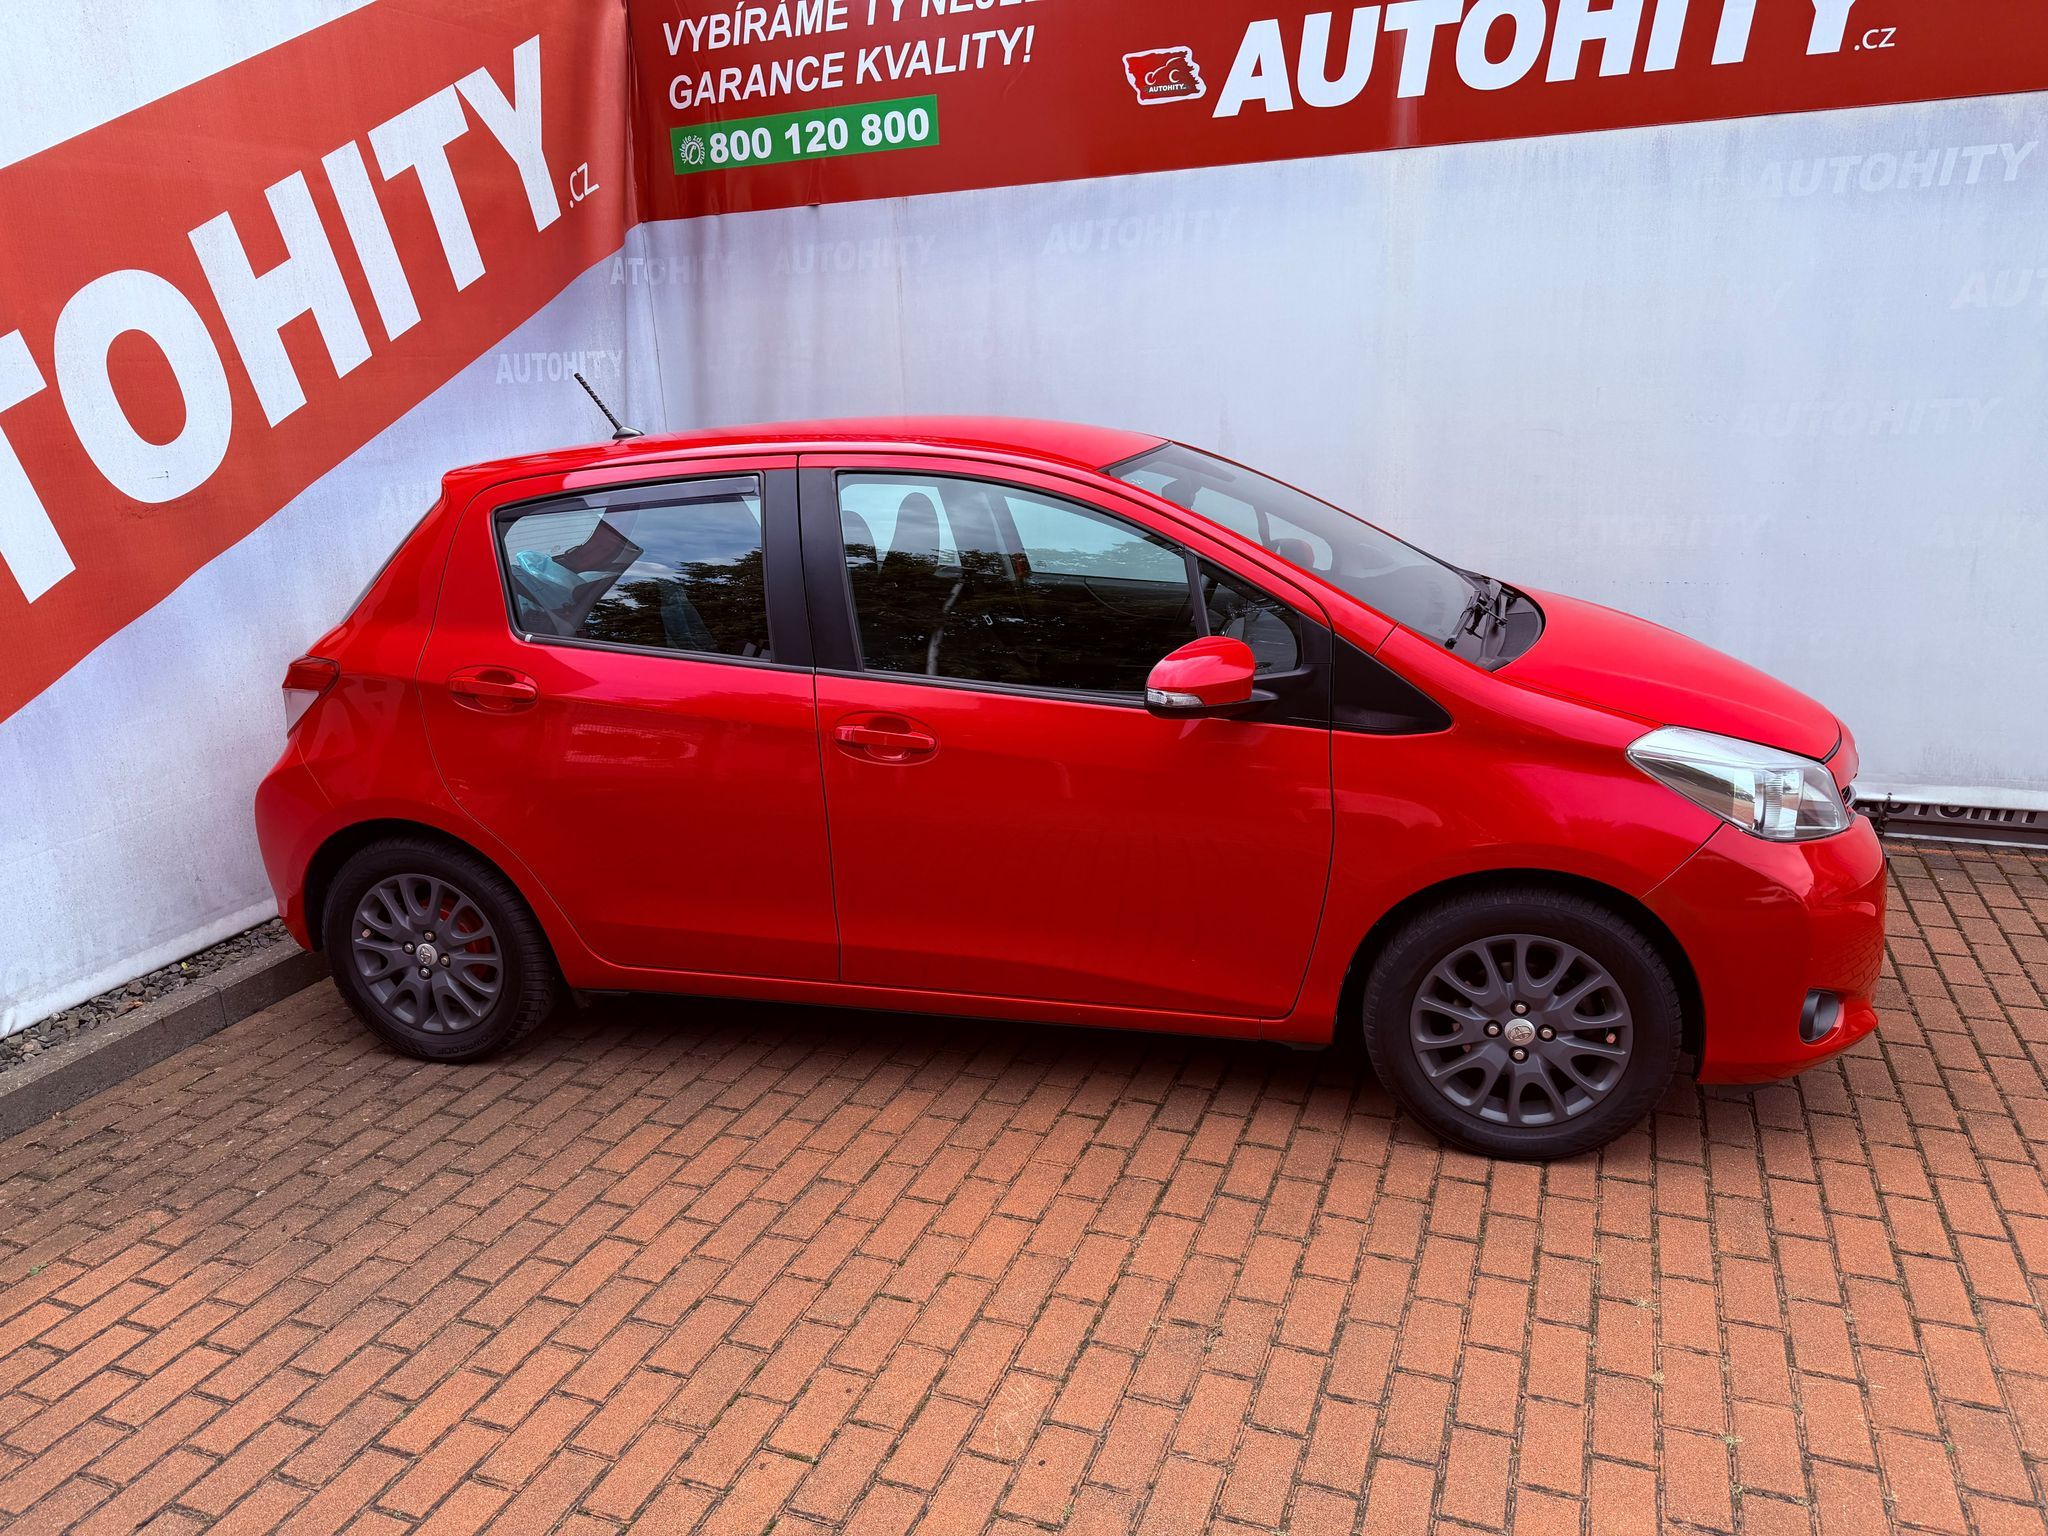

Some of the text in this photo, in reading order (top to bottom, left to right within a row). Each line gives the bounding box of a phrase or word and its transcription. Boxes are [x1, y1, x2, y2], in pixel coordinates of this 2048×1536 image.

[662, 0, 849, 56] VYBÍRÁME
[669, 25, 1036, 110] GARANCE KVALITY!
[1148, 83, 1185, 93] AUTOHITY
[709, 107, 930, 164] 800 120 800
[1756, 141, 2039, 199] AUTOHITY
[495, 349, 623, 385] AUTOHITY
